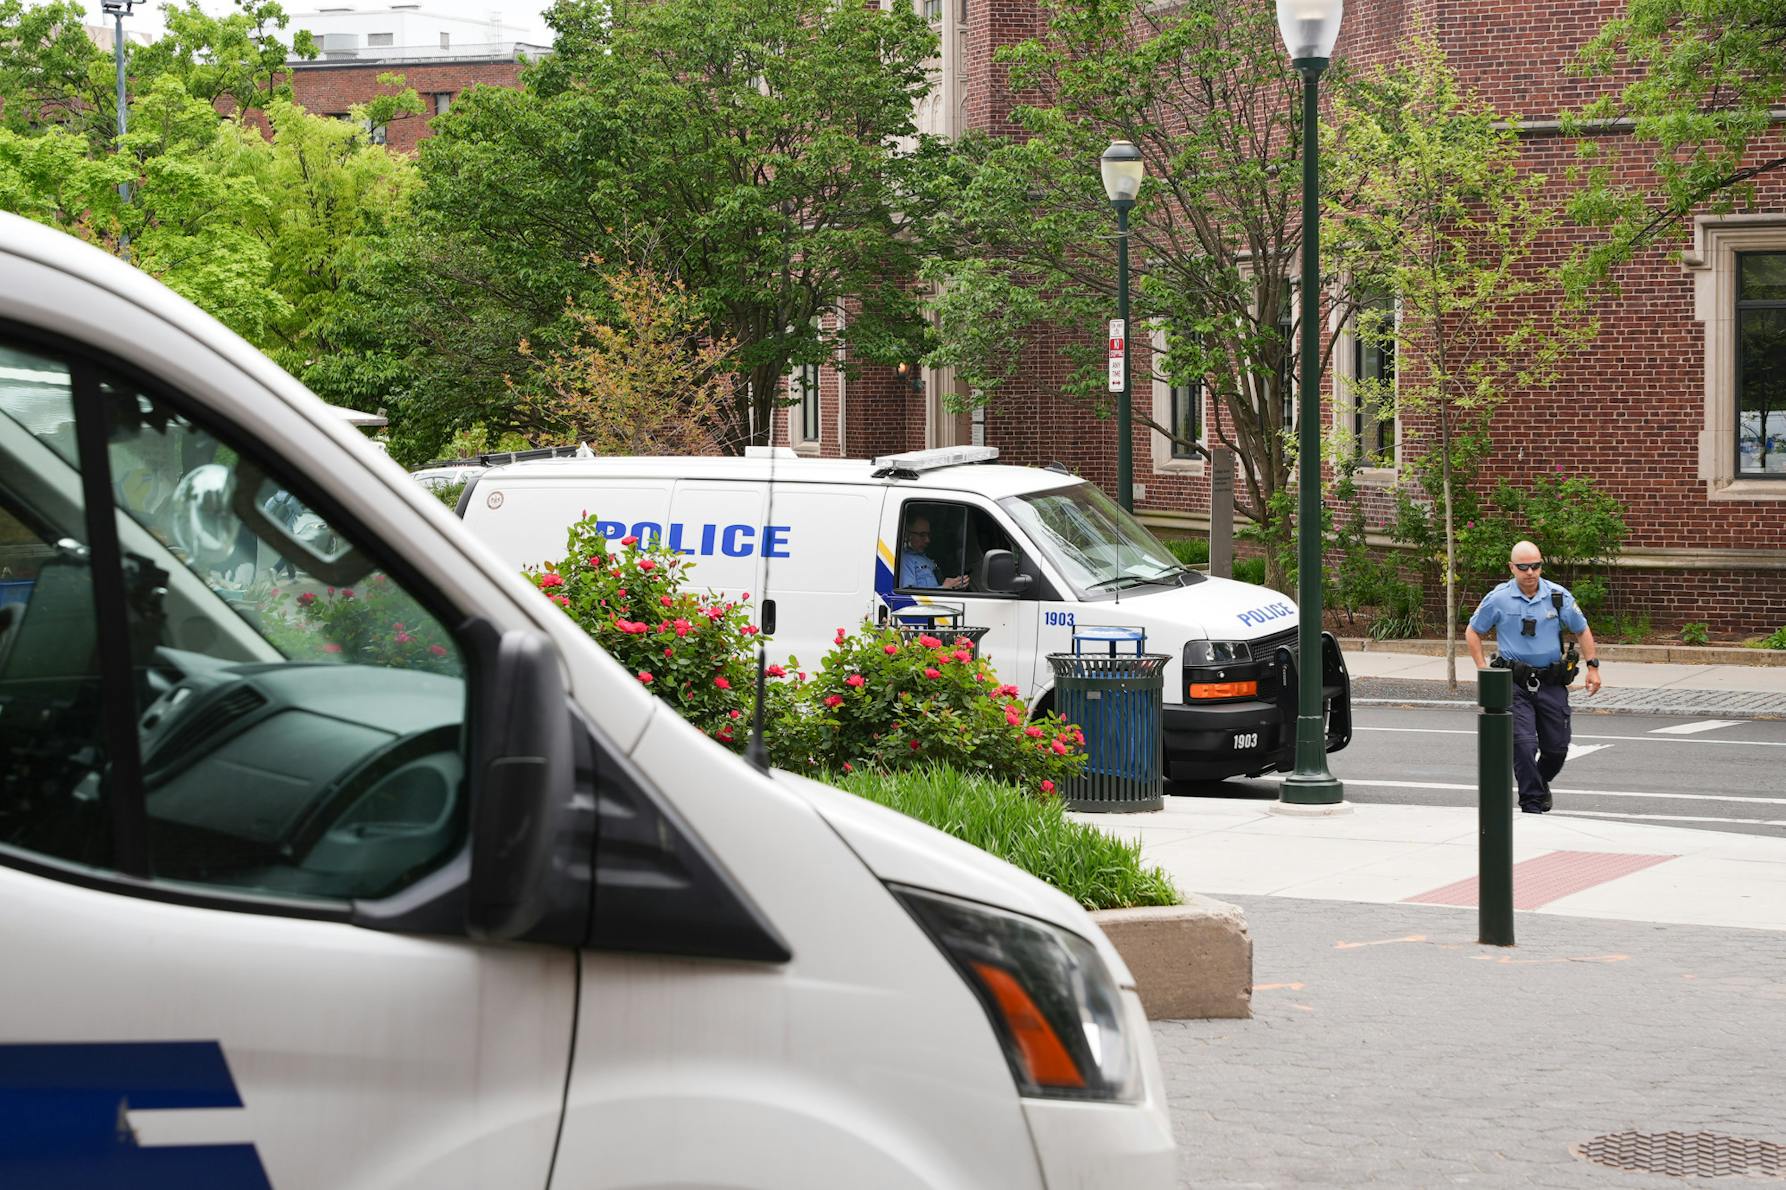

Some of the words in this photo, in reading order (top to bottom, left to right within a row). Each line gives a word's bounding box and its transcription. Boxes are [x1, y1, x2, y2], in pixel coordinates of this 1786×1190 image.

[595, 521, 791, 558] POLICE
[1045, 612, 1074, 626] 1903
[1237, 602, 1294, 627] POLICE
[1234, 733, 1257, 749] 1903
